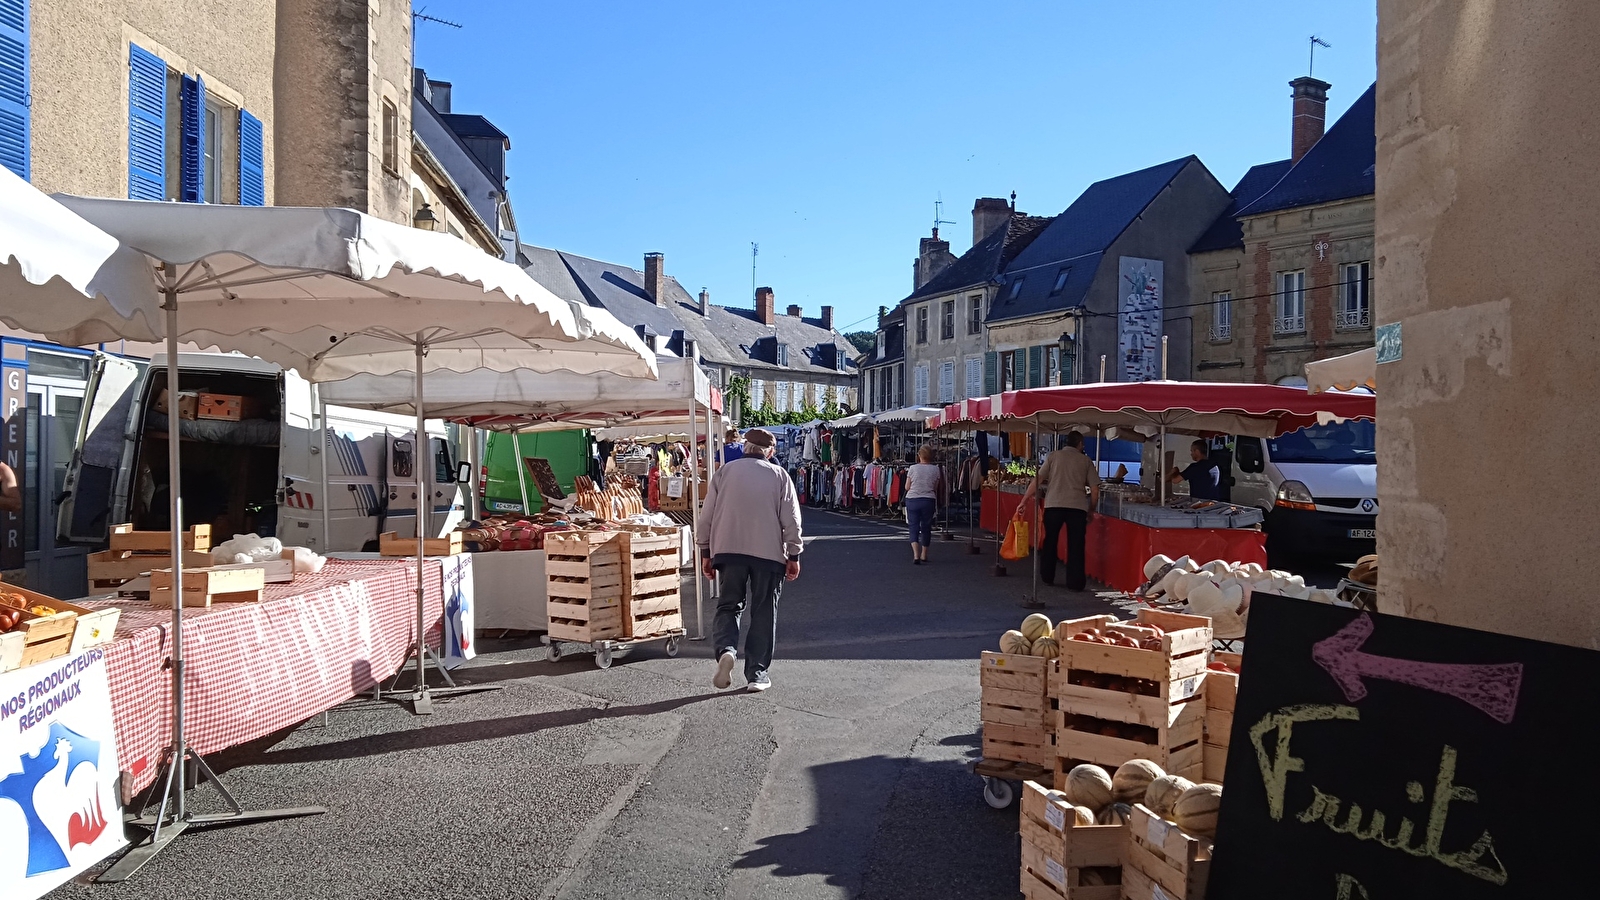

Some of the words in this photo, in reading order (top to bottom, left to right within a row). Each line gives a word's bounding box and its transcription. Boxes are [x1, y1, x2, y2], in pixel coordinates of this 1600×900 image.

[1, 692, 26, 721] NOS
[28, 648, 103, 704] PRODUCTEURS
[19, 679, 81, 734] RÉGIONAUX
[1249, 703, 1508, 886] Fruits
